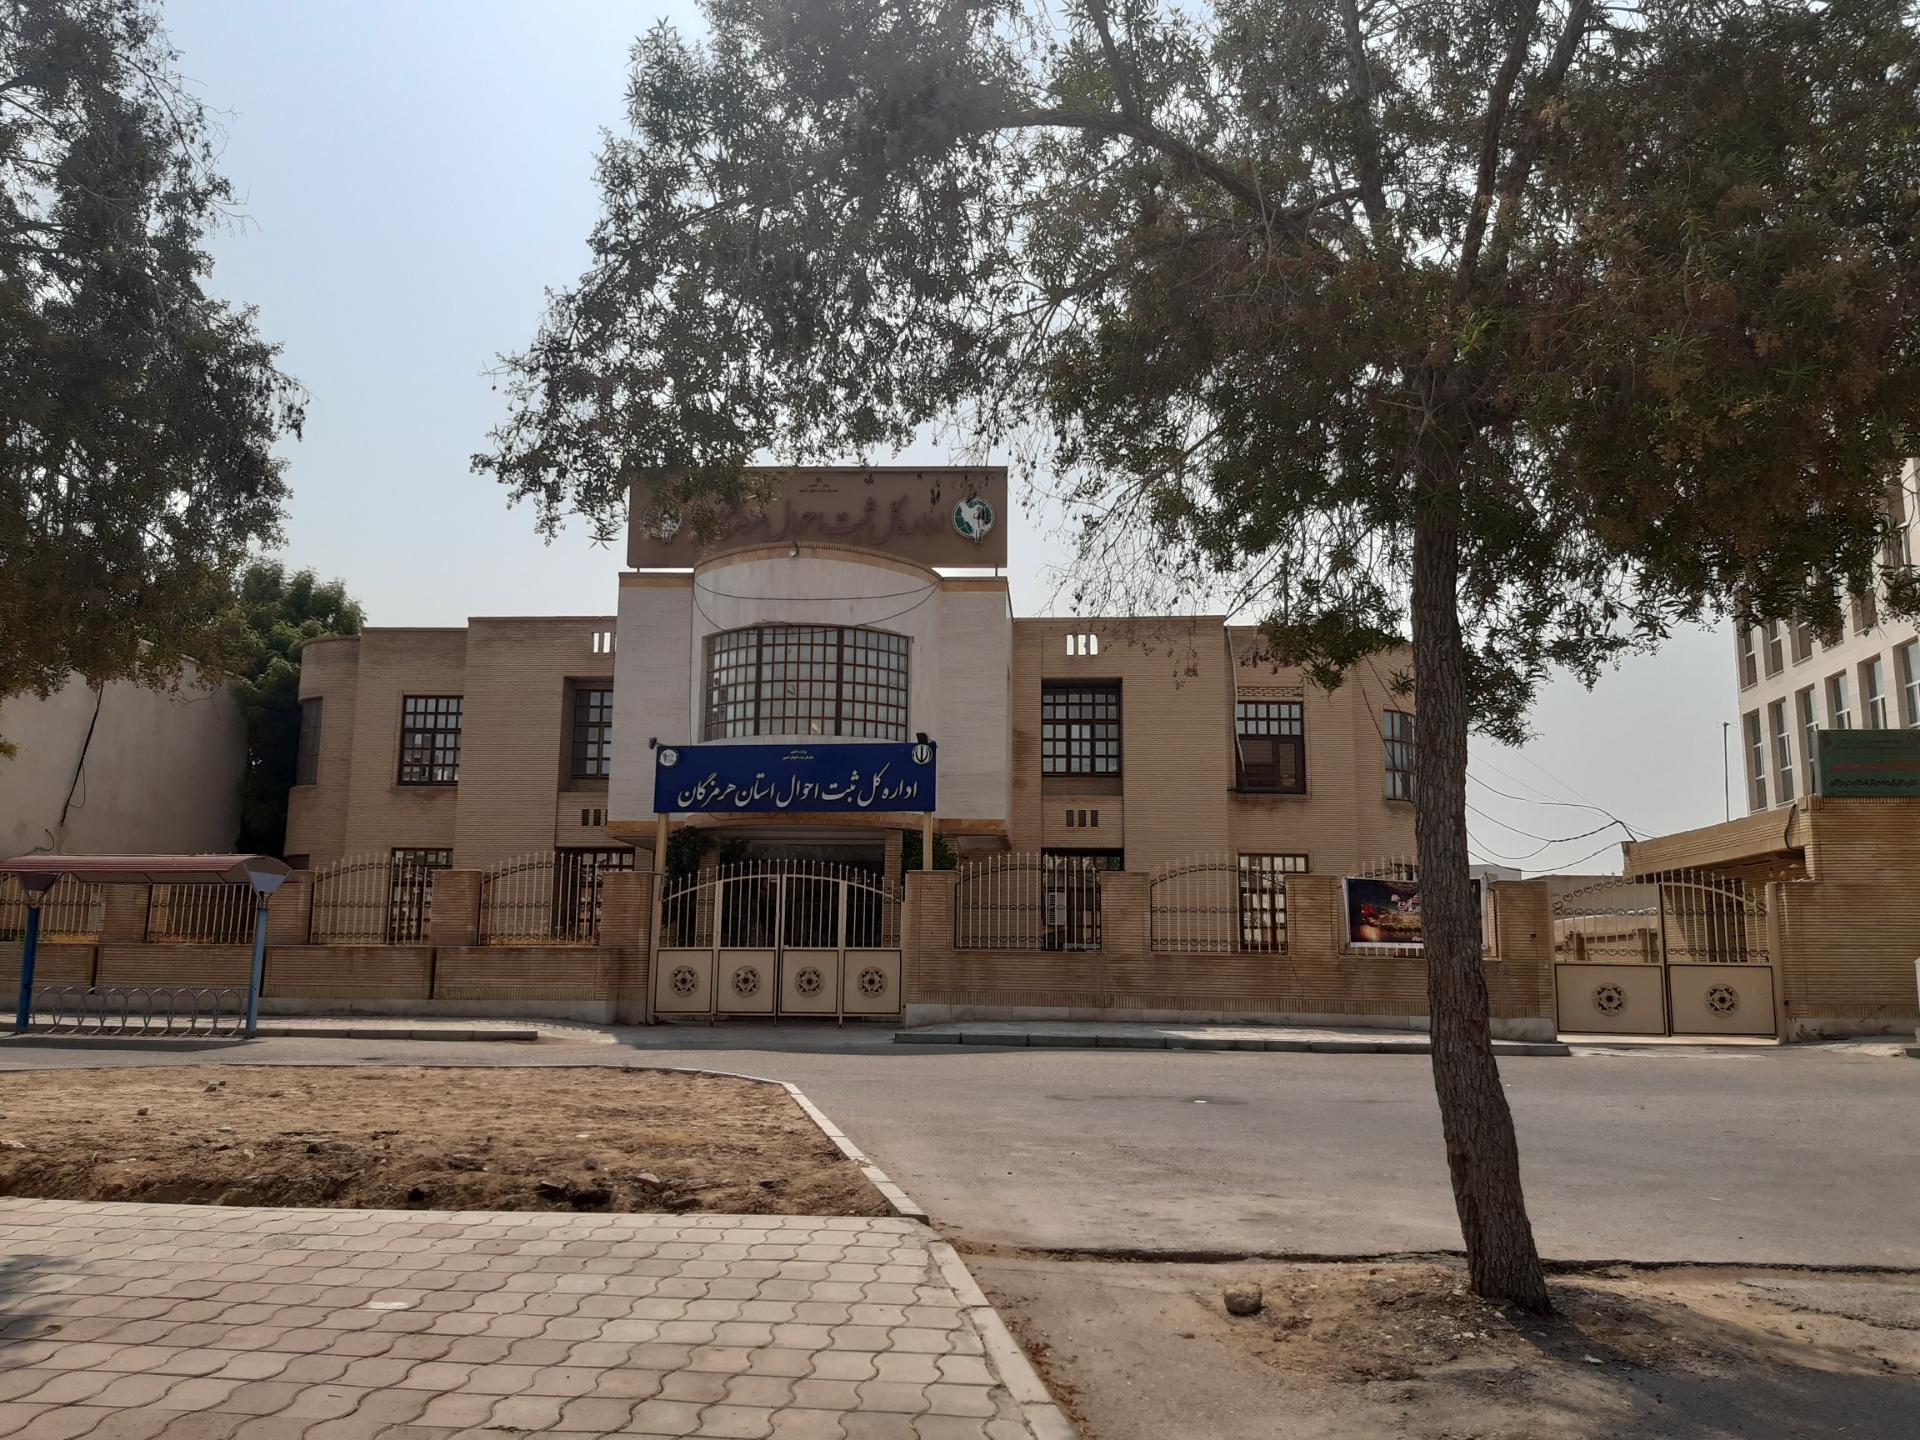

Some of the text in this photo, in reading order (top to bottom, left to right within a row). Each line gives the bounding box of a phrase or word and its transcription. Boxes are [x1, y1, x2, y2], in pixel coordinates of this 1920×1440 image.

[677, 761, 918, 808] اداره کل ثبت احوال استان هرمزگان
